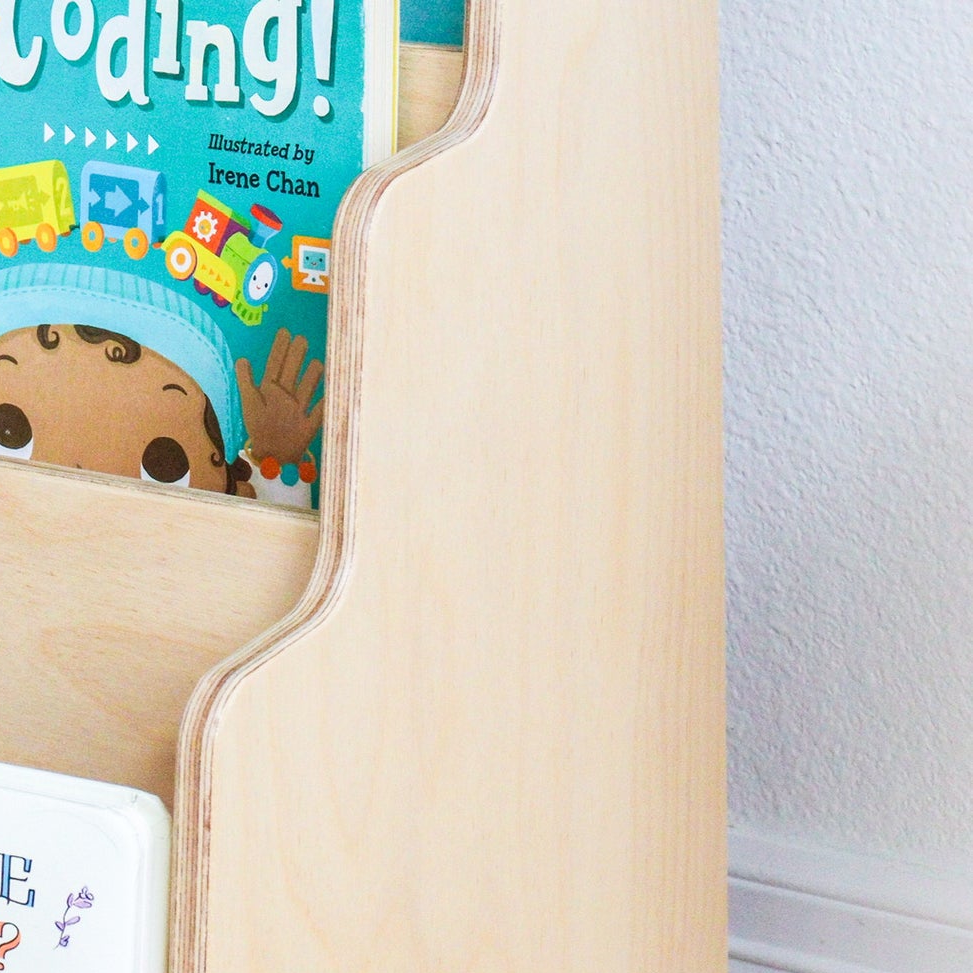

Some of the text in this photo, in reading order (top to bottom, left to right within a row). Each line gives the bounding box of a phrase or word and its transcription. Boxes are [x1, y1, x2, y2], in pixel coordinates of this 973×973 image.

[207, 133, 315, 164] Illustrated by
[208, 162, 320, 198] Irene Chan
